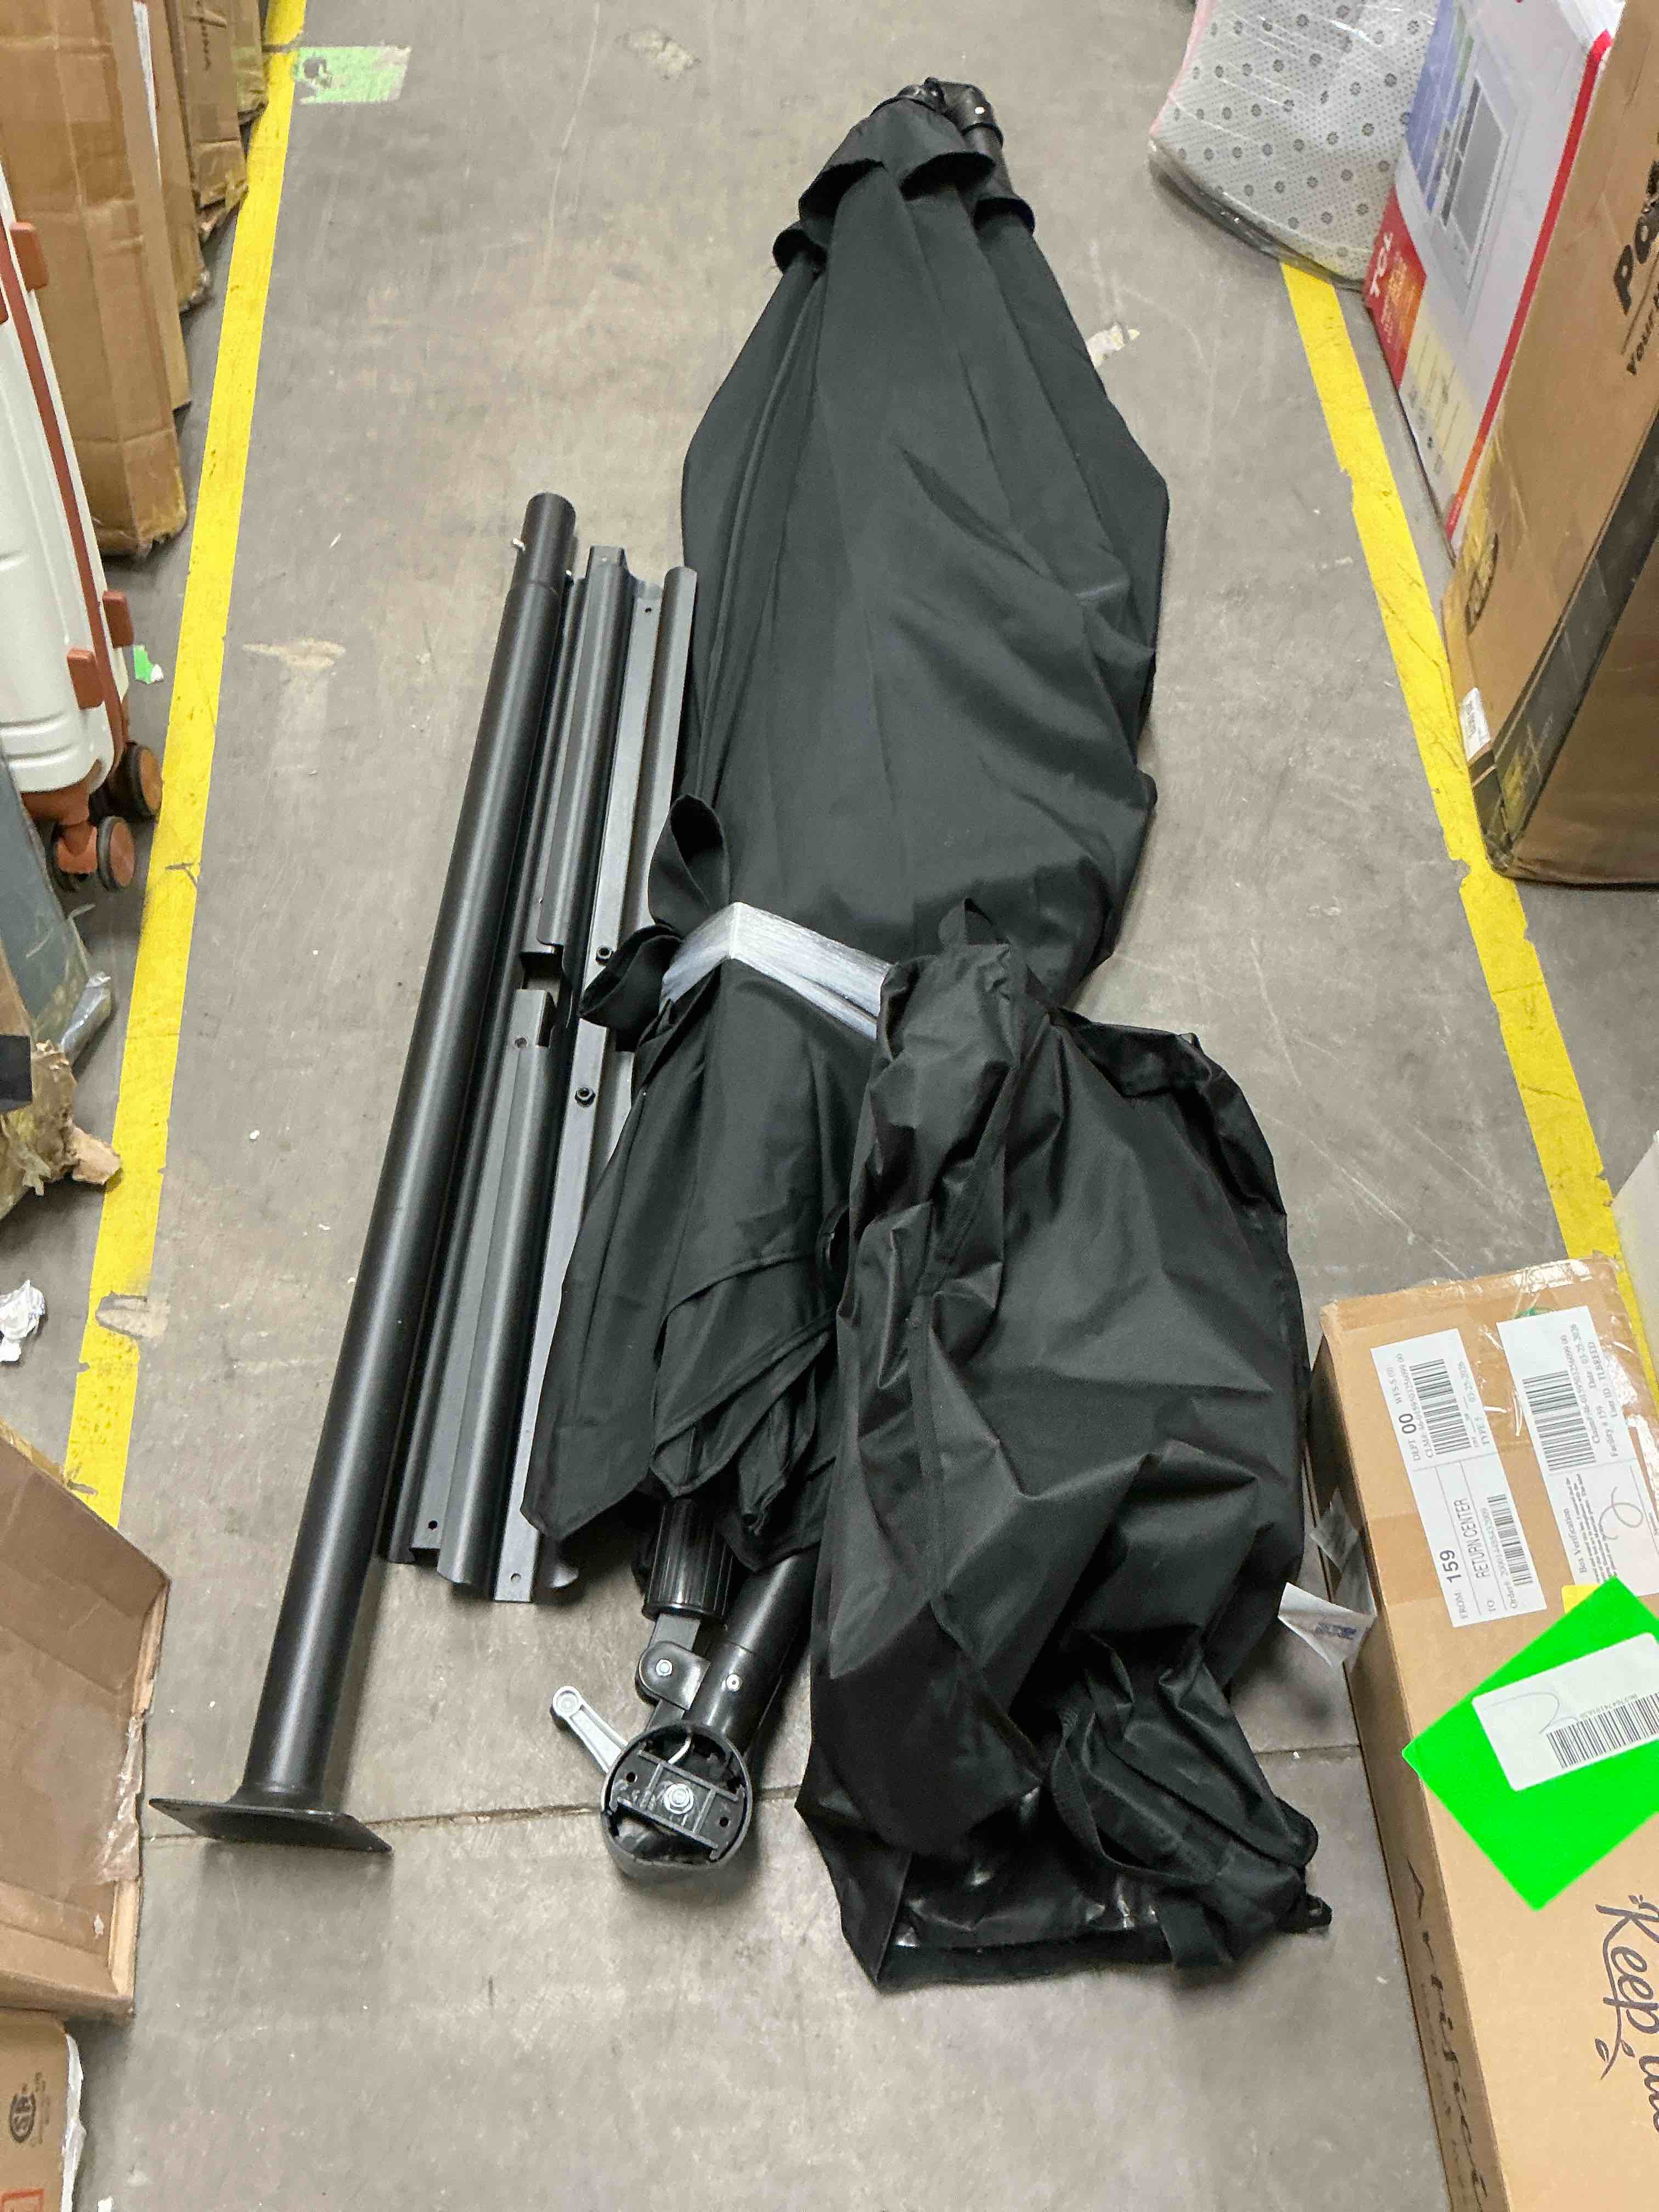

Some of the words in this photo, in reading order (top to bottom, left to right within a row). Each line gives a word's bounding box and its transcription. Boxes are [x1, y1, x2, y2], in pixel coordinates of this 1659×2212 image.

[1397, 1412, 1418, 1435] 00
[1594, 1404, 1606, 1419] 159
[1602, 1428, 1621, 1457] Facility
[1452, 1497, 1479, 1538] CENTER
[1563, 1508, 1582, 1556] Verification
[1438, 1548, 1463, 1583] 159
[1465, 1538, 1491, 1578] RETURN
[1579, 1558, 1588, 1573] Box
[1594, 1894, 1659, 2036] Keep
